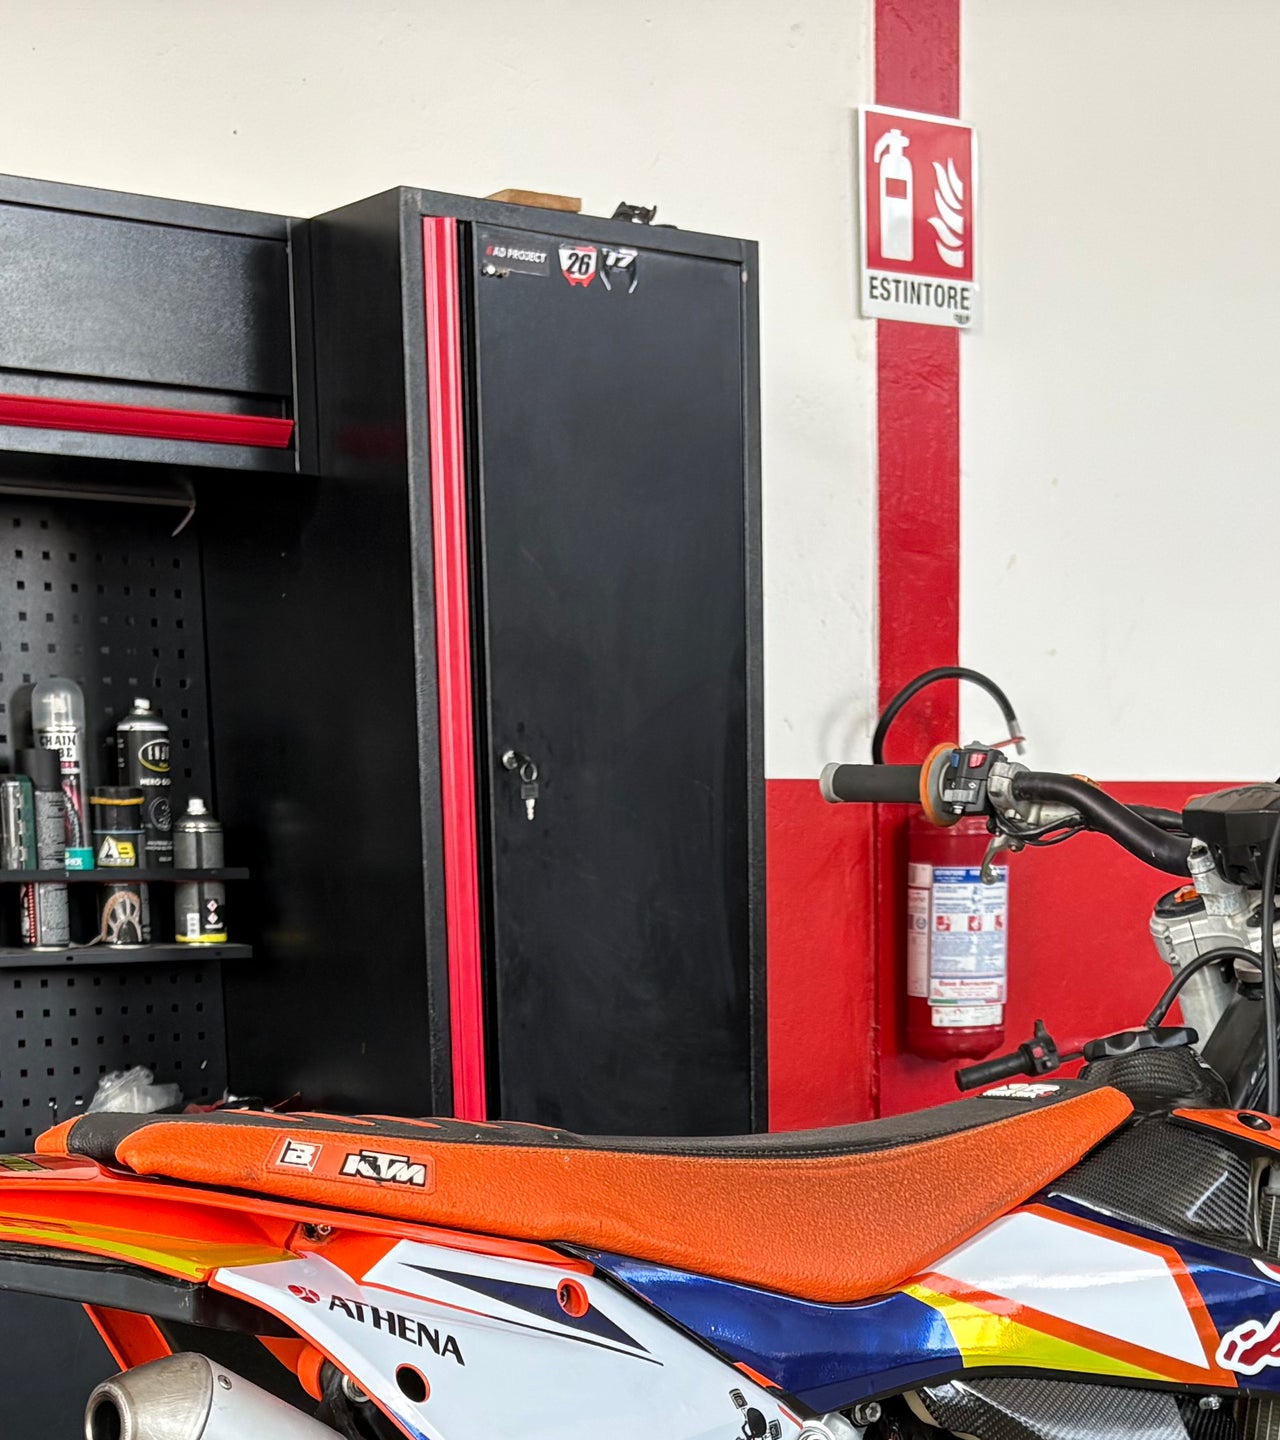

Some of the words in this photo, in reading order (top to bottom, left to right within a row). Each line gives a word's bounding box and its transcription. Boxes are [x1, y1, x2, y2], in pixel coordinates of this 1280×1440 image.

[507, 248, 548, 264] PROJECT
[568, 252, 591, 276] 26
[869, 276, 970, 311] ESTINTORE
[40, 733, 76, 746] CHAIN
[339, 1149, 427, 1187] KTM
[329, 1295, 465, 1367] ATHENA
